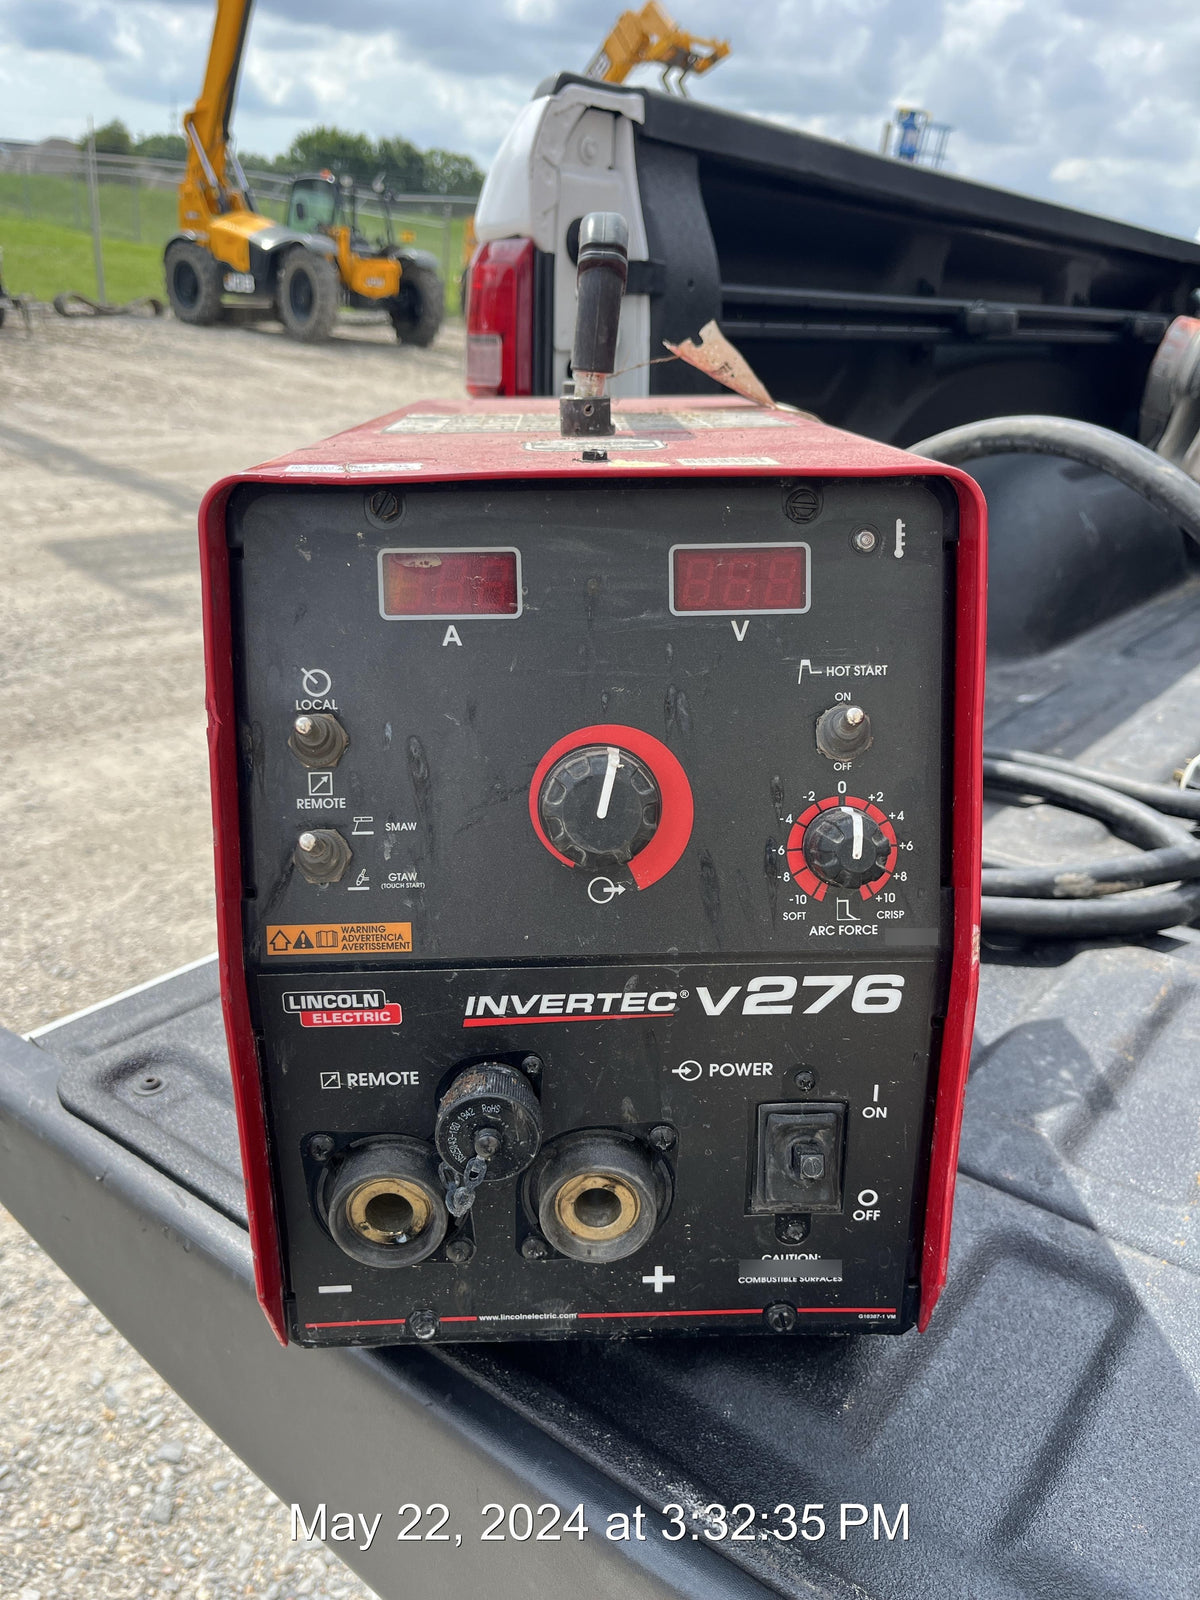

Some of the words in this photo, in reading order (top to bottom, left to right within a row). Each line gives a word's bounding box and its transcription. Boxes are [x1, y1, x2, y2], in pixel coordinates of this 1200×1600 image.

[443, 625, 462, 646] A
[731, 621, 749, 641] V
[827, 666, 850, 676] HOT
[854, 665, 887, 675] START
[835, 693, 850, 701] ON
[296, 700, 338, 710] LOCAL
[834, 762, 851, 770] OFF
[838, 781, 846, 793] 0
[803, 791, 815, 801] -2
[869, 792, 883, 801] +2
[297, 798, 345, 808] REMOTE
[780, 814, 792, 823] -4
[889, 811, 904, 820] +4
[386, 823, 416, 831] SMAW
[900, 841, 913, 850] +6
[772, 846, 785, 855] -6
[389, 873, 417, 881] GTAW
[778, 872, 790, 882] -8
[894, 872, 907, 881] +8
[790, 895, 806, 904] -10
[876, 893, 895, 902] +10
[783, 912, 806, 920] SOFT
[877, 911, 904, 919] CRISP
[341, 925, 386, 934] WARNING
[809, 926, 835, 935] ARC
[839, 925, 877, 935] FORCE
[341, 934, 404, 942] ADVERTENCIA
[341, 941, 411, 951] AVERTISSEMENT
[288, 993, 379, 1010] LINCOLN
[312, 1011, 391, 1024] ELECTRIC
[710, 1063, 773, 1077] POWER
[348, 1072, 419, 1088] REMOTE
[457, 1108, 476, 1121] 1942
[481, 1104, 502, 1114] RoHS
[863, 1107, 887, 1118] ON
[853, 1210, 880, 1220] OFF
[478, 1312, 577, 1321] www.lincolnelectric.com
